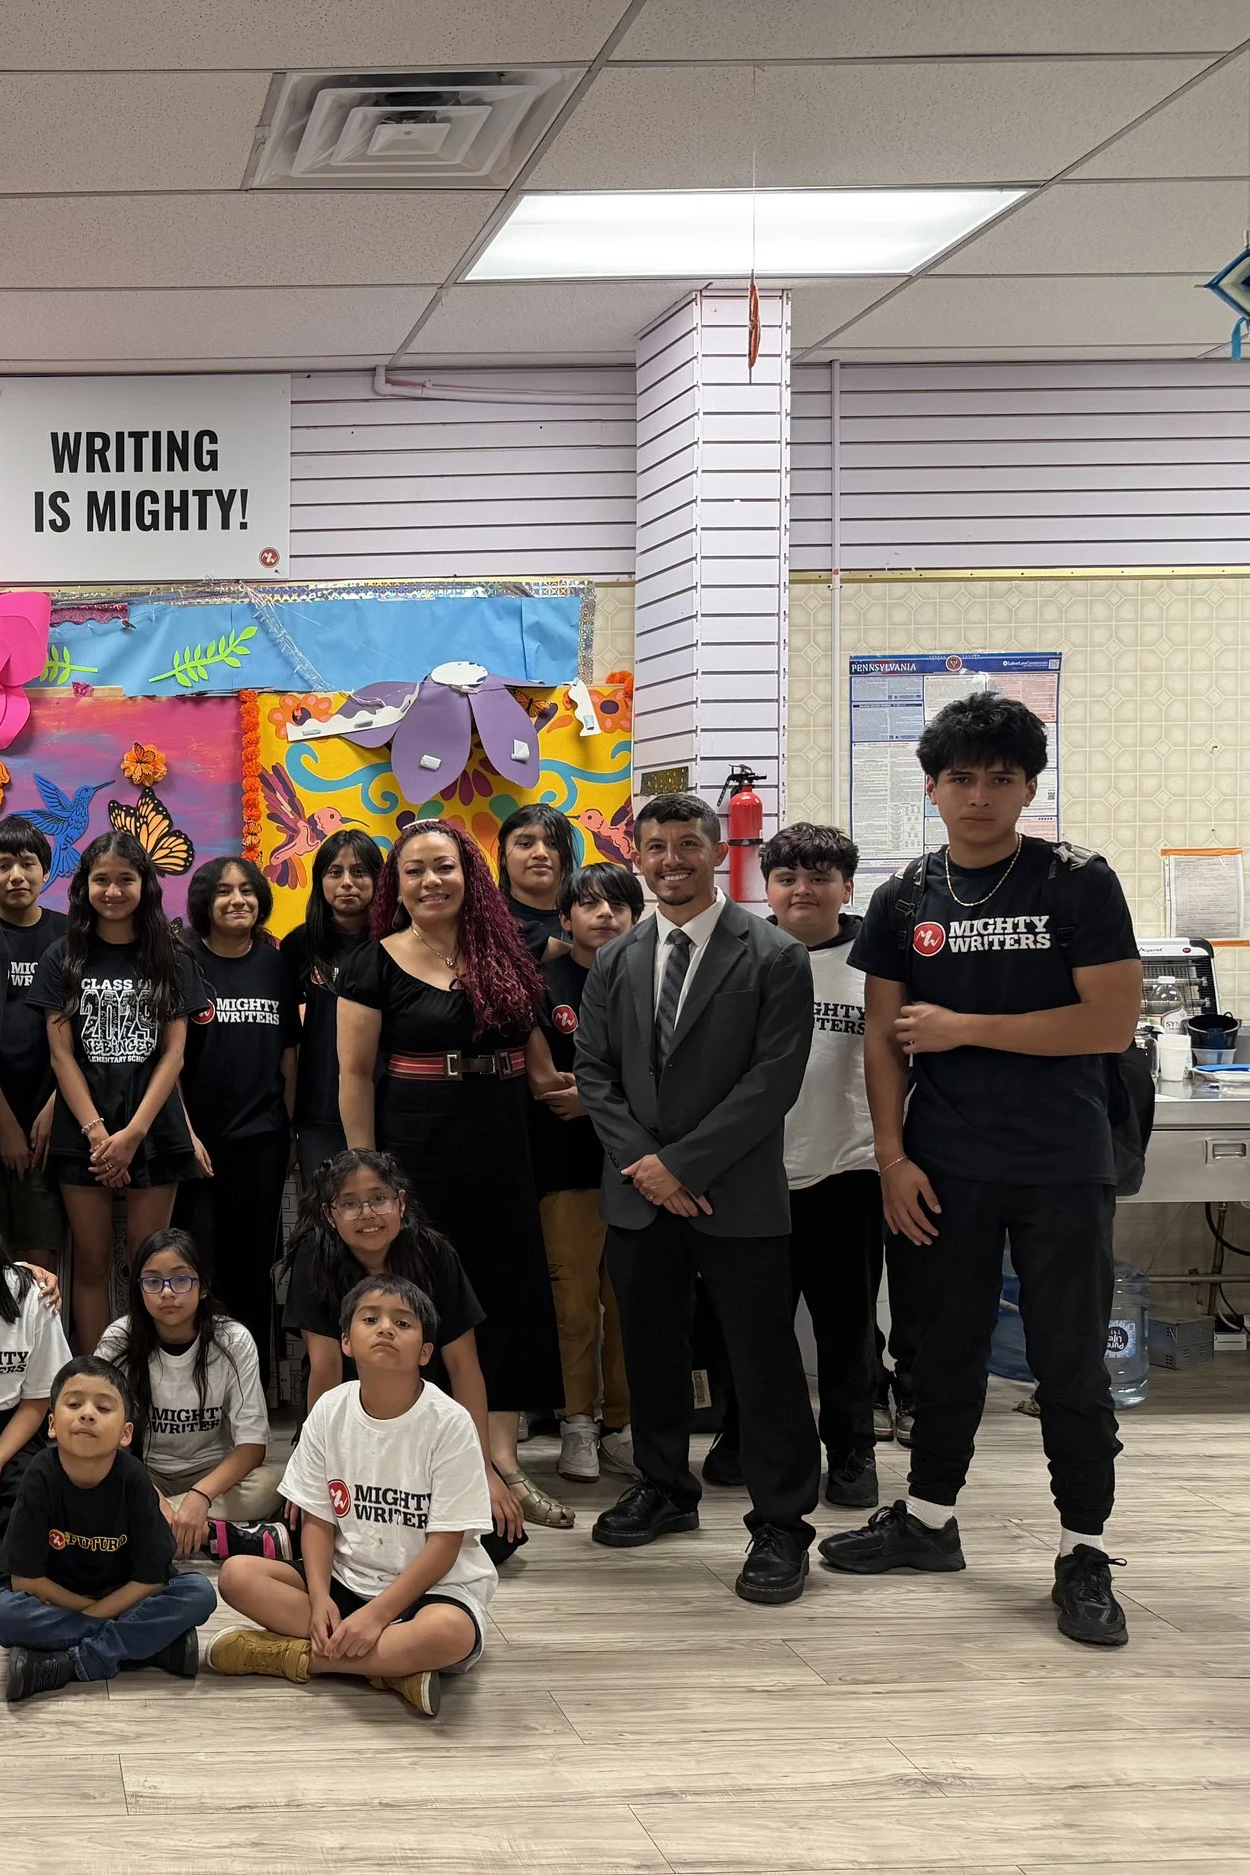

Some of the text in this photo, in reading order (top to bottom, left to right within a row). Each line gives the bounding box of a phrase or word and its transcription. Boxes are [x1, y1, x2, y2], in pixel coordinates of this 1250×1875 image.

[50, 429, 219, 473] WRITING
[34, 488, 249, 533] IS MIGHTY!
[851, 663, 917, 673] PENNSYLVANIA
[949, 915, 1050, 937] MIGHTY
[948, 933, 1051, 953] WRITERS
[81, 978, 133, 990] CLASS
[216, 997, 280, 1013] MIGHTY
[216, 1010, 280, 1026] WRITERS
[151, 1406, 223, 1423] MIGHT
